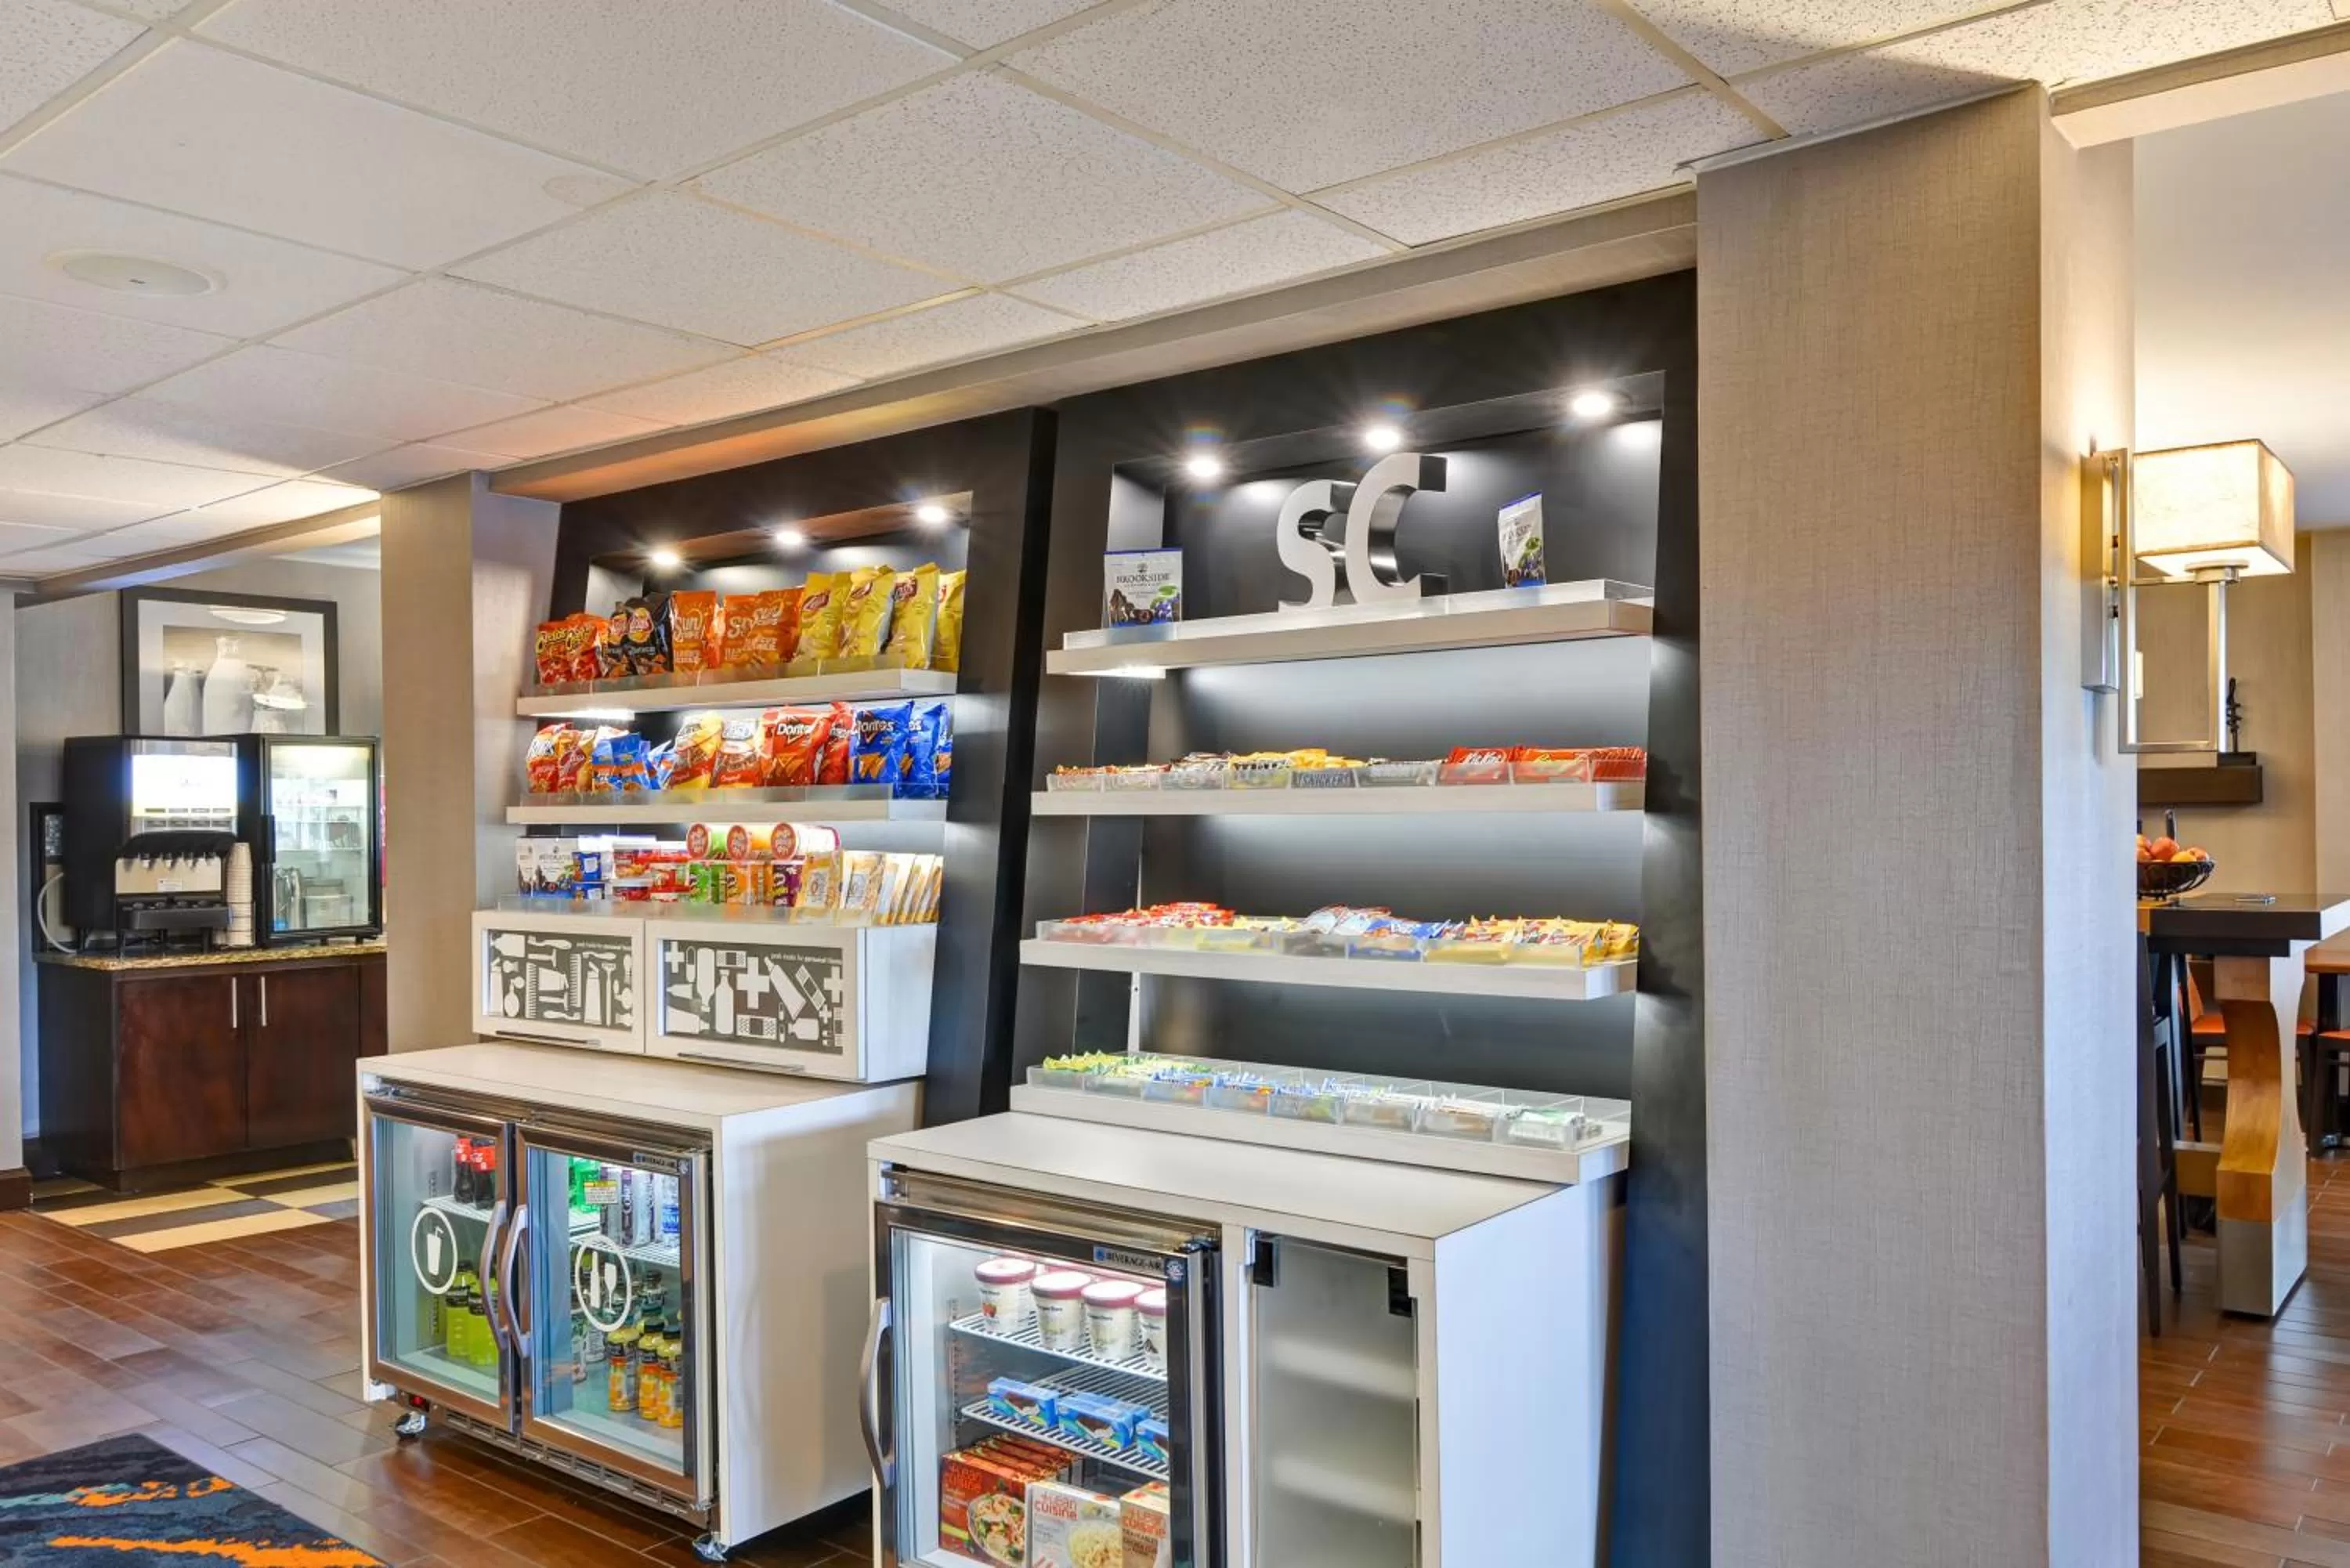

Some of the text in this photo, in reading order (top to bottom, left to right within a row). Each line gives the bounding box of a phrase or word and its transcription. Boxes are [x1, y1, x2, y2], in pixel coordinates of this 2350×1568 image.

[1276, 452, 1448, 611] SC
[1116, 573, 1171, 583] BROOKSIDE
[1106, 1251, 1163, 1270] BEVERAGE-AIR
